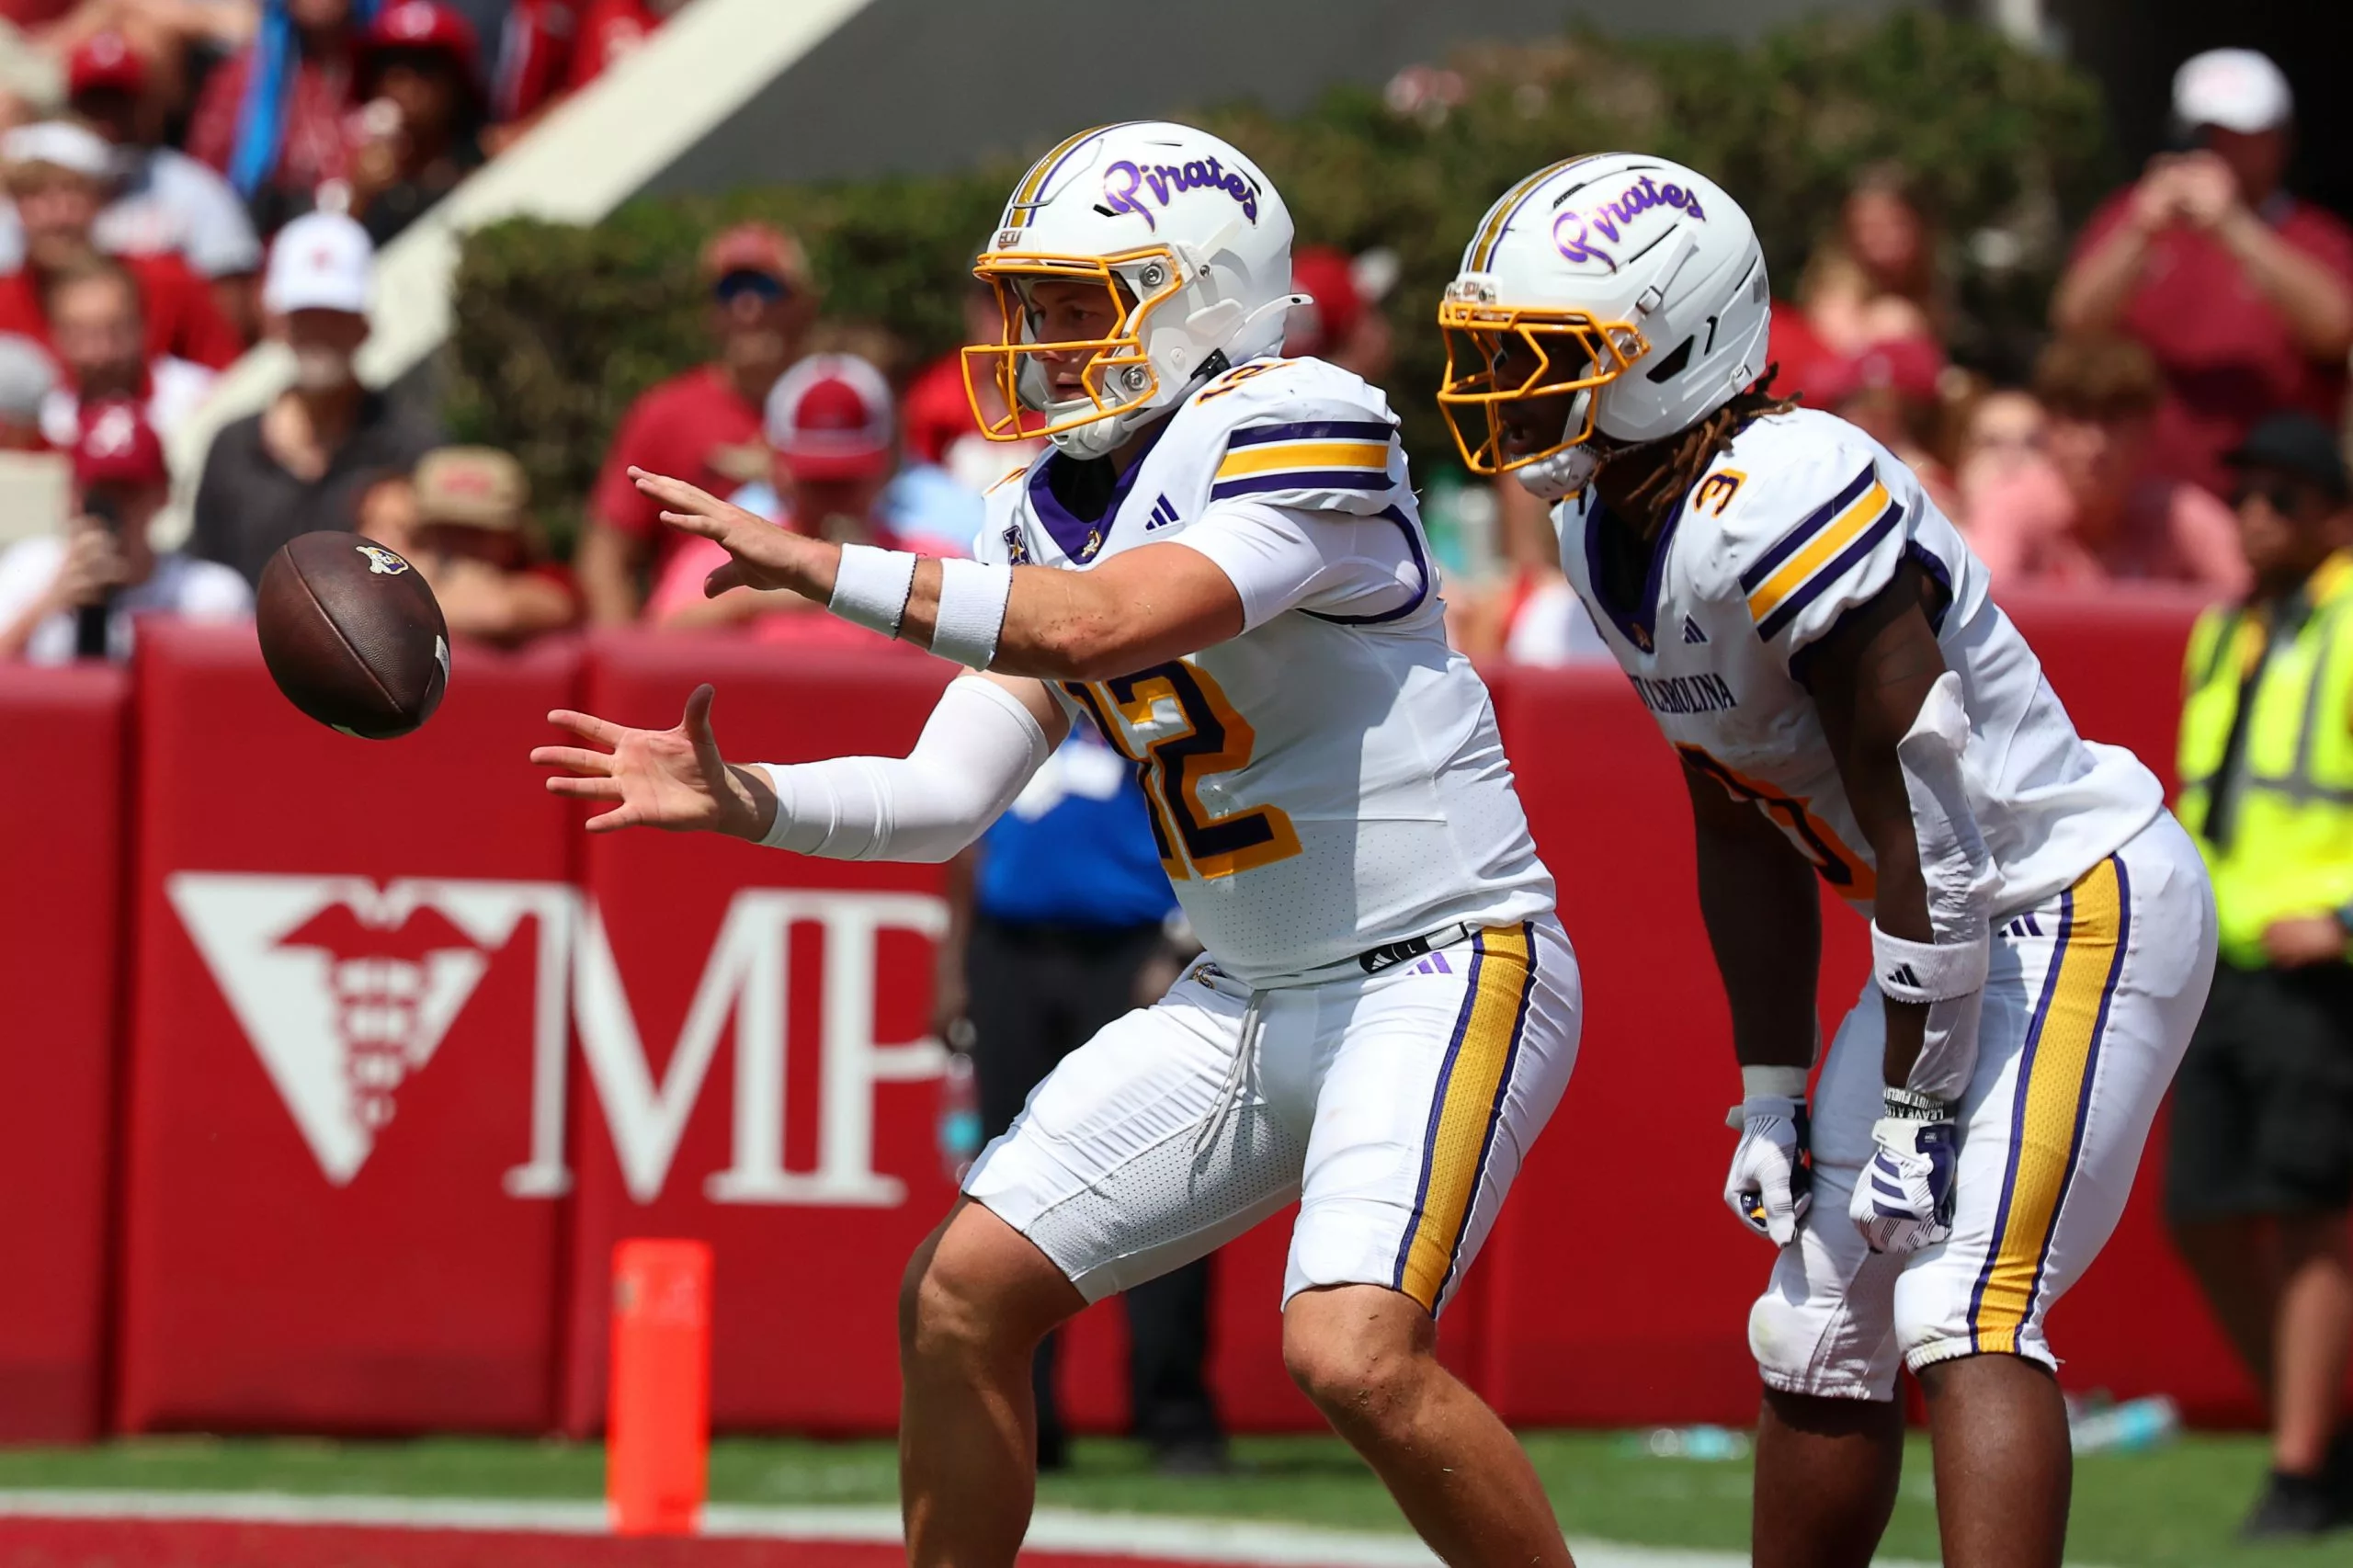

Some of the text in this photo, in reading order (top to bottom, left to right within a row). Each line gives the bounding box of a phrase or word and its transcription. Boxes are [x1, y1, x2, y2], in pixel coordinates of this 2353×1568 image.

[1103, 154, 1258, 232] Pirates
[1552, 176, 1707, 274] Pirates
[1693, 468, 1747, 519] 3
[1643, 672, 1737, 713] CAROLINA
[1057, 659, 1303, 881] 12
[1407, 943, 1417, 954] L
